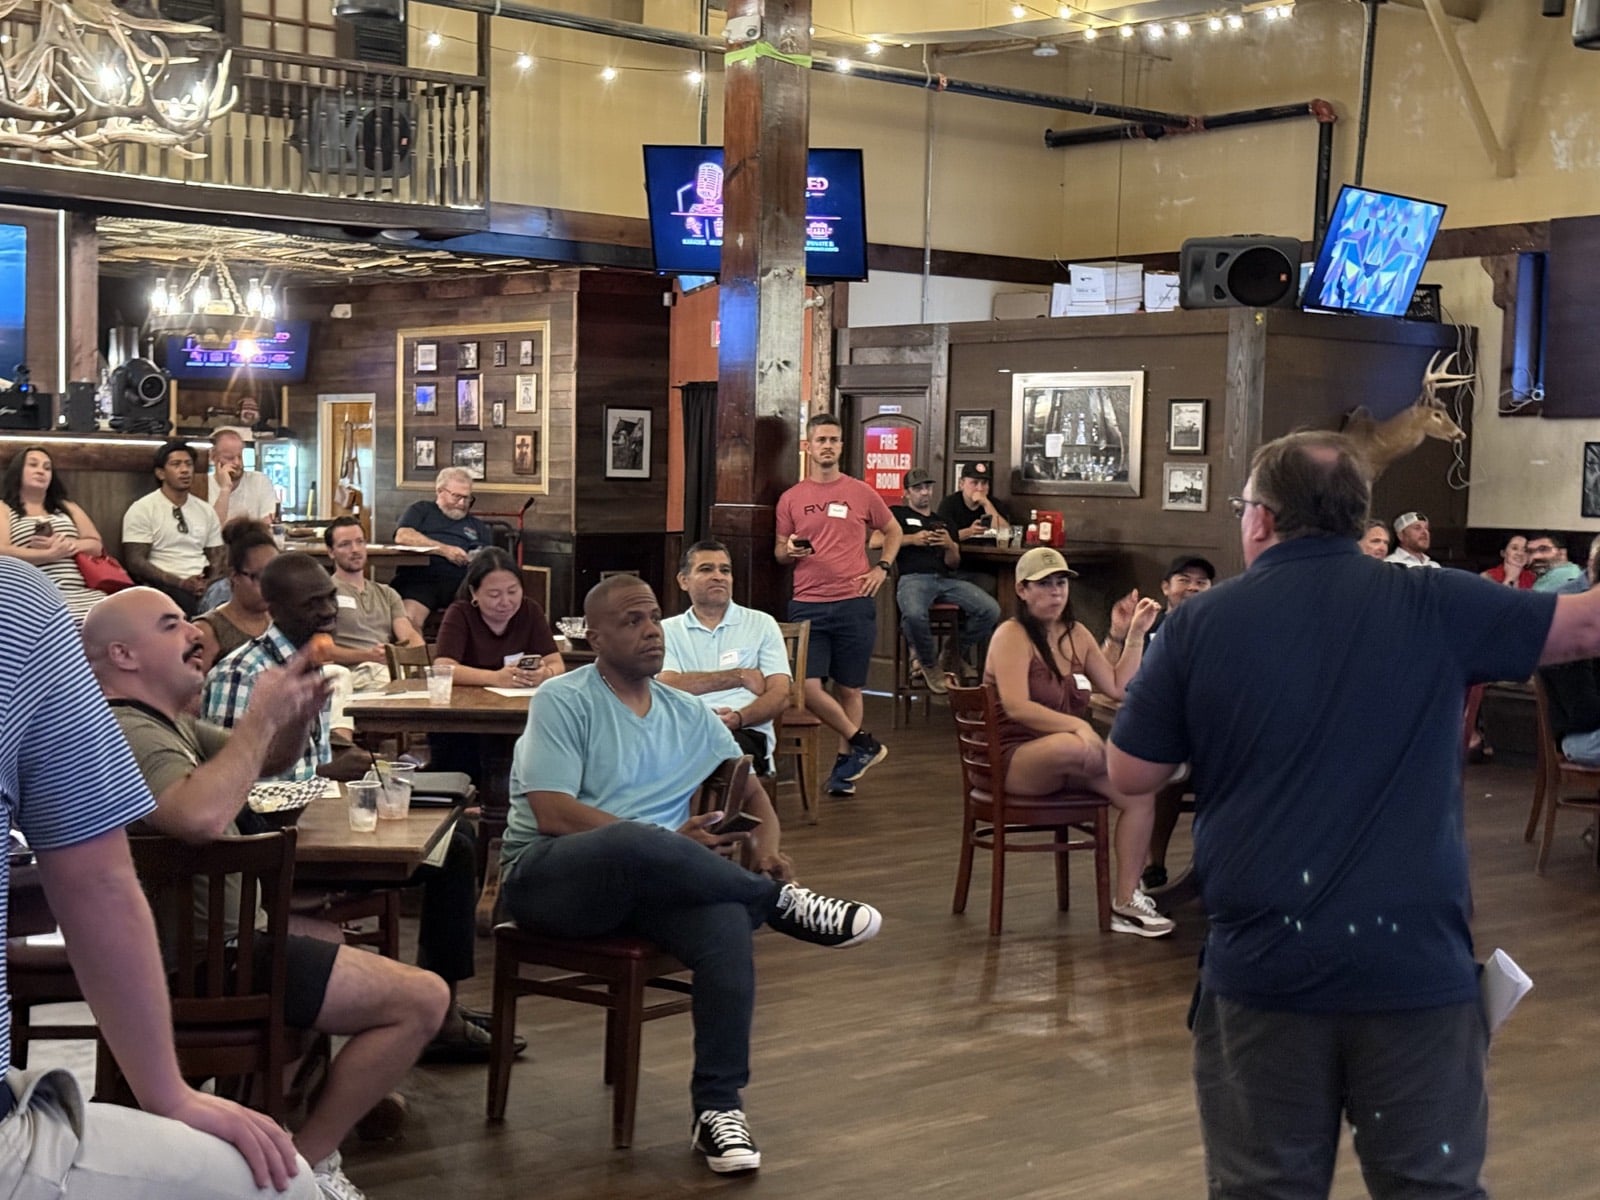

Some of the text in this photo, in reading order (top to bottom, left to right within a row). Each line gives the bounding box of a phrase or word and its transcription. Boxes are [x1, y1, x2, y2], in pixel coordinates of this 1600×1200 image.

[880, 433, 899, 450] FIRE
[866, 453, 911, 470] SPRINKLER
[876, 472, 900, 489] ROOM
[804, 501, 852, 516] RVA
